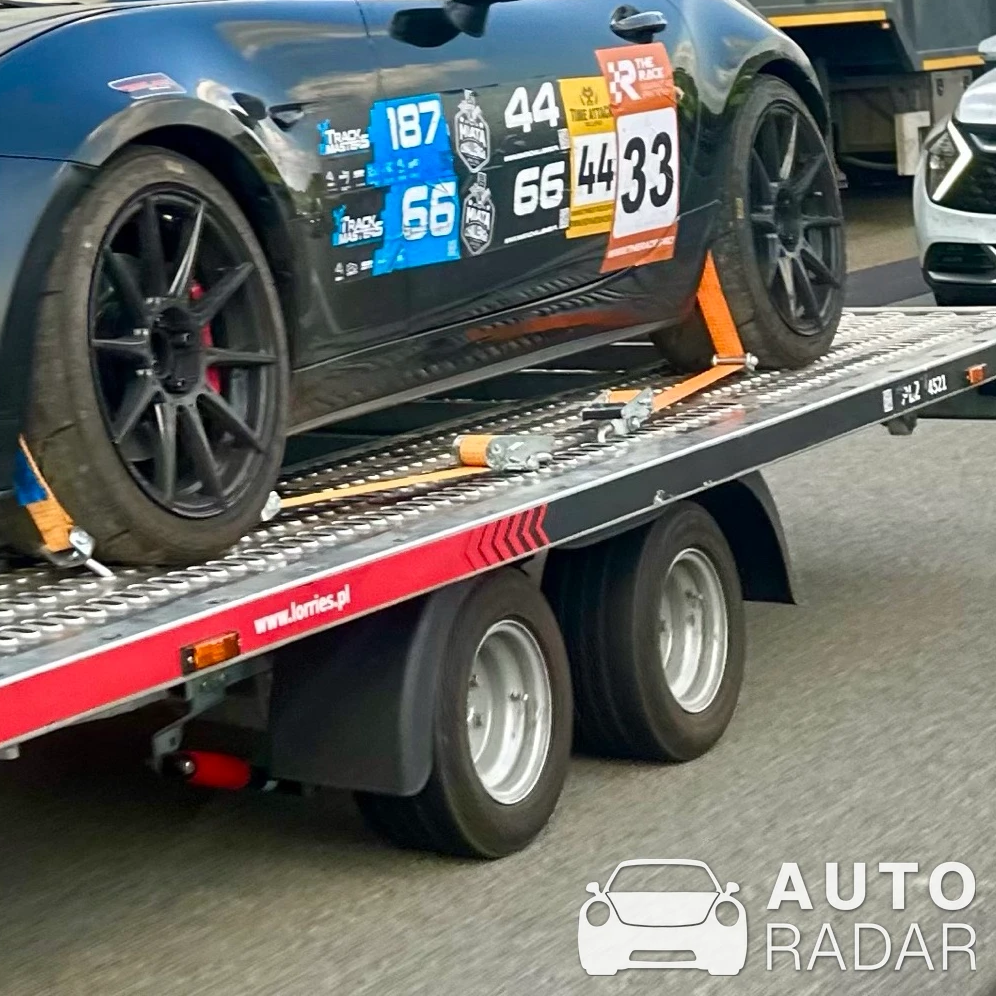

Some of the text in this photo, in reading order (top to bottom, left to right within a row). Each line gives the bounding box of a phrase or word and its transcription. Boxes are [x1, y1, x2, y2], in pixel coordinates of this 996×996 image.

[634, 56, 654, 69] THE
[638, 67, 664, 82] RACE
[386, 99, 441, 151] 187
[505, 82, 560, 133] 44
[324, 128, 361, 145] TRACK
[325, 134, 370, 154] MASTERS
[514, 161, 565, 216] 66
[578, 142, 614, 194] 44
[621, 131, 674, 214] 33
[338, 220, 383, 245] MASTERS
[340, 214, 376, 234] TRACK
[402, 182, 456, 241] 66
[254, 584, 351, 634] www.lorries.pl
